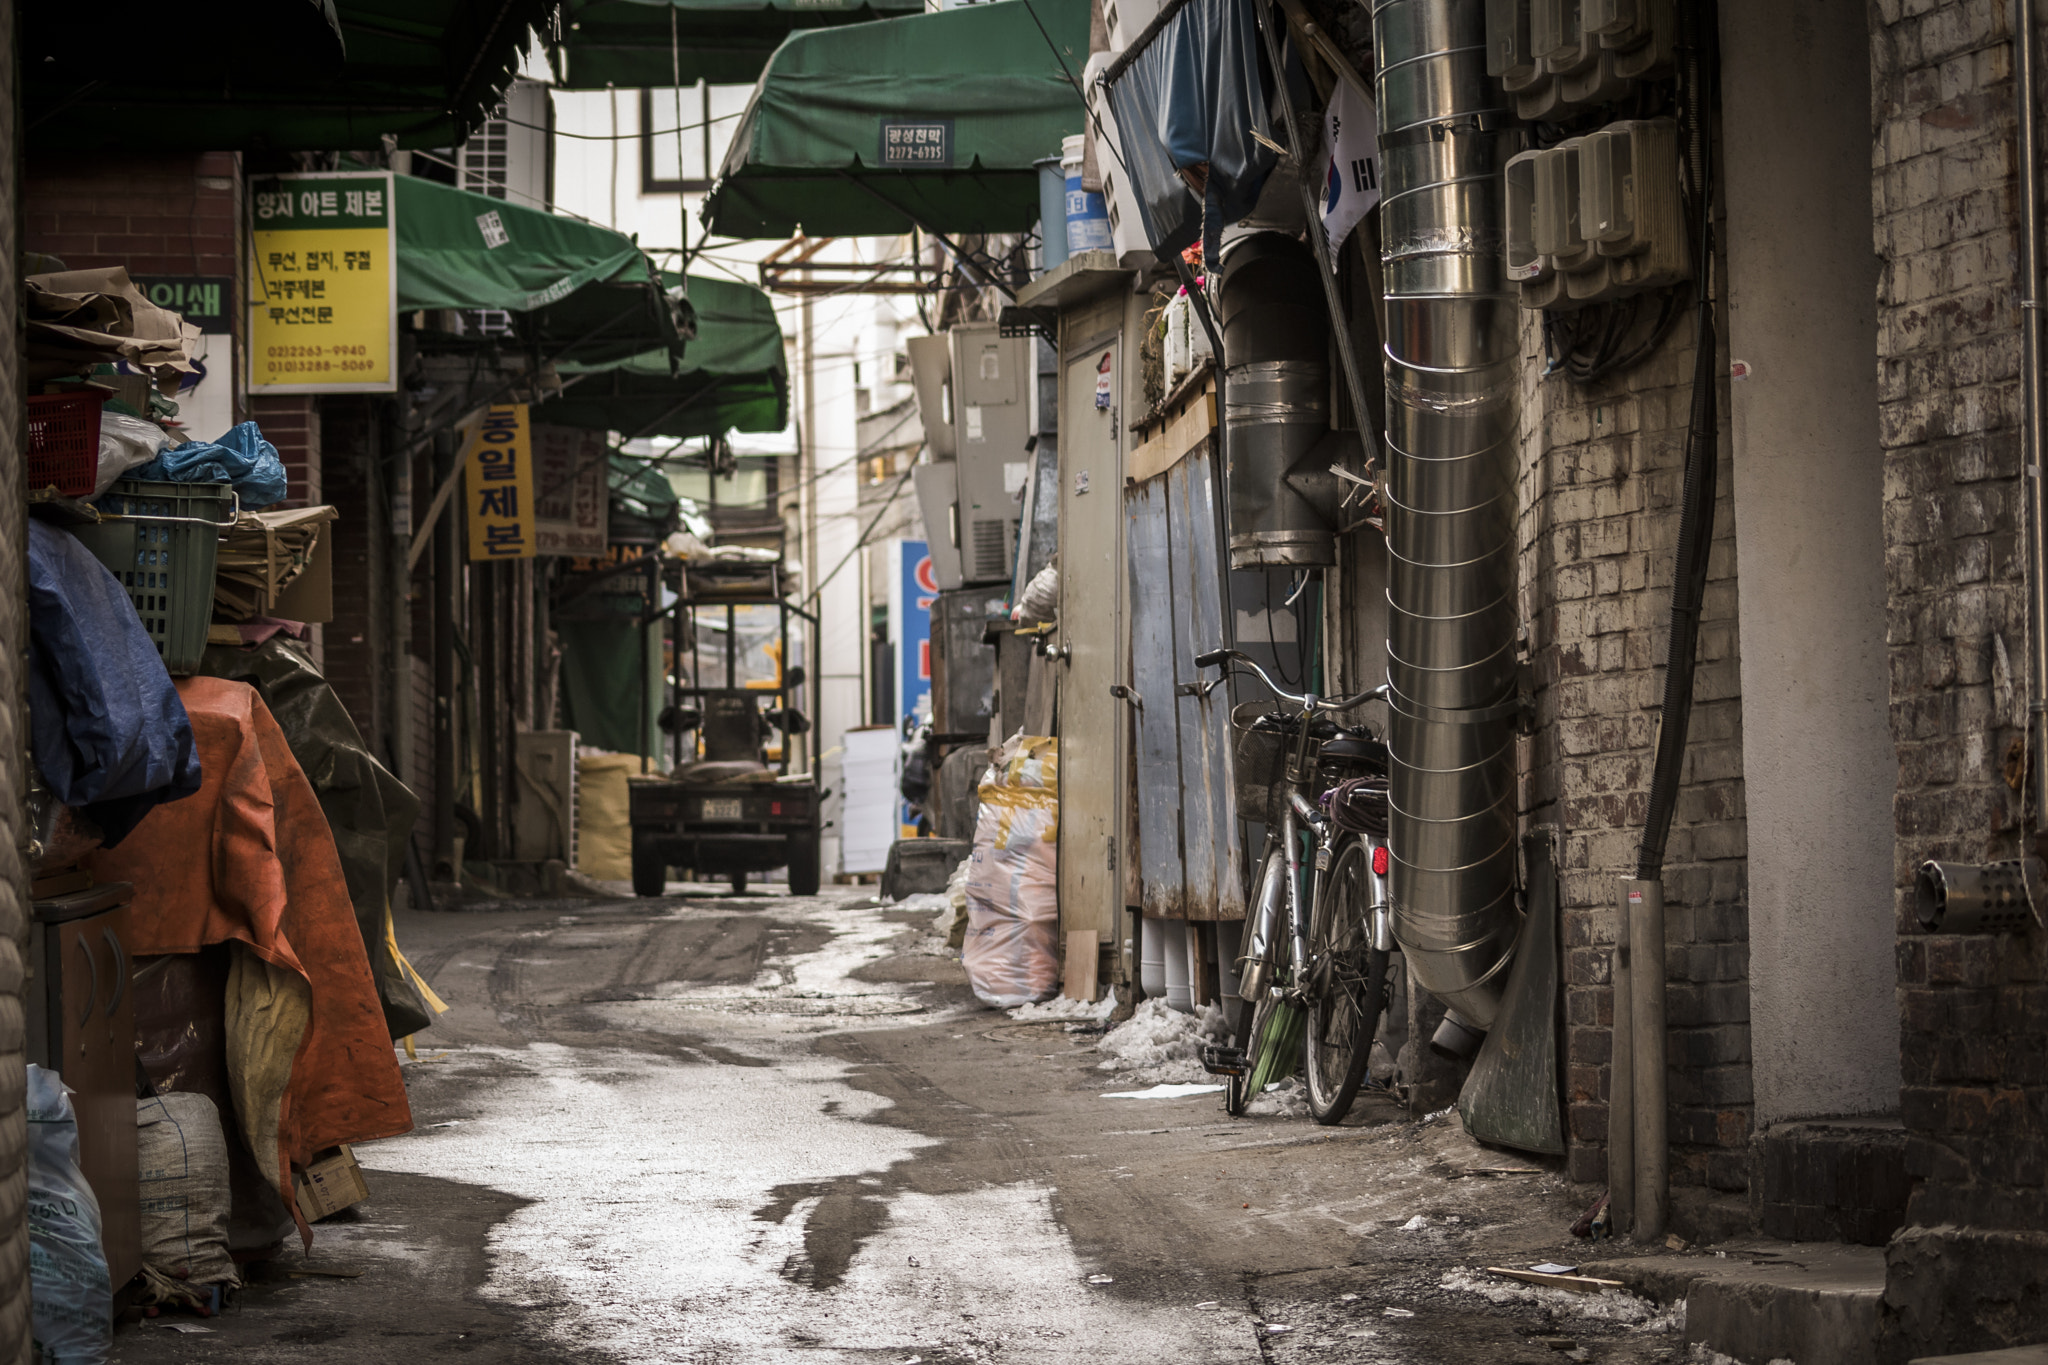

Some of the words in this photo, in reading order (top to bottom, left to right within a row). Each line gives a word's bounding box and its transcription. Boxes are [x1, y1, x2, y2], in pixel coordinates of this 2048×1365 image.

[889, 129, 941, 144] 광성천막
[256, 192, 294, 219] 양지
[300, 191, 338, 217] 아트
[345, 190, 383, 216] 제본
[268, 251, 301, 273] 무선,
[268, 279, 325, 300] 각종제본
[269, 306, 333, 325] 무선전문
[478, 411, 525, 556] 동일제본
